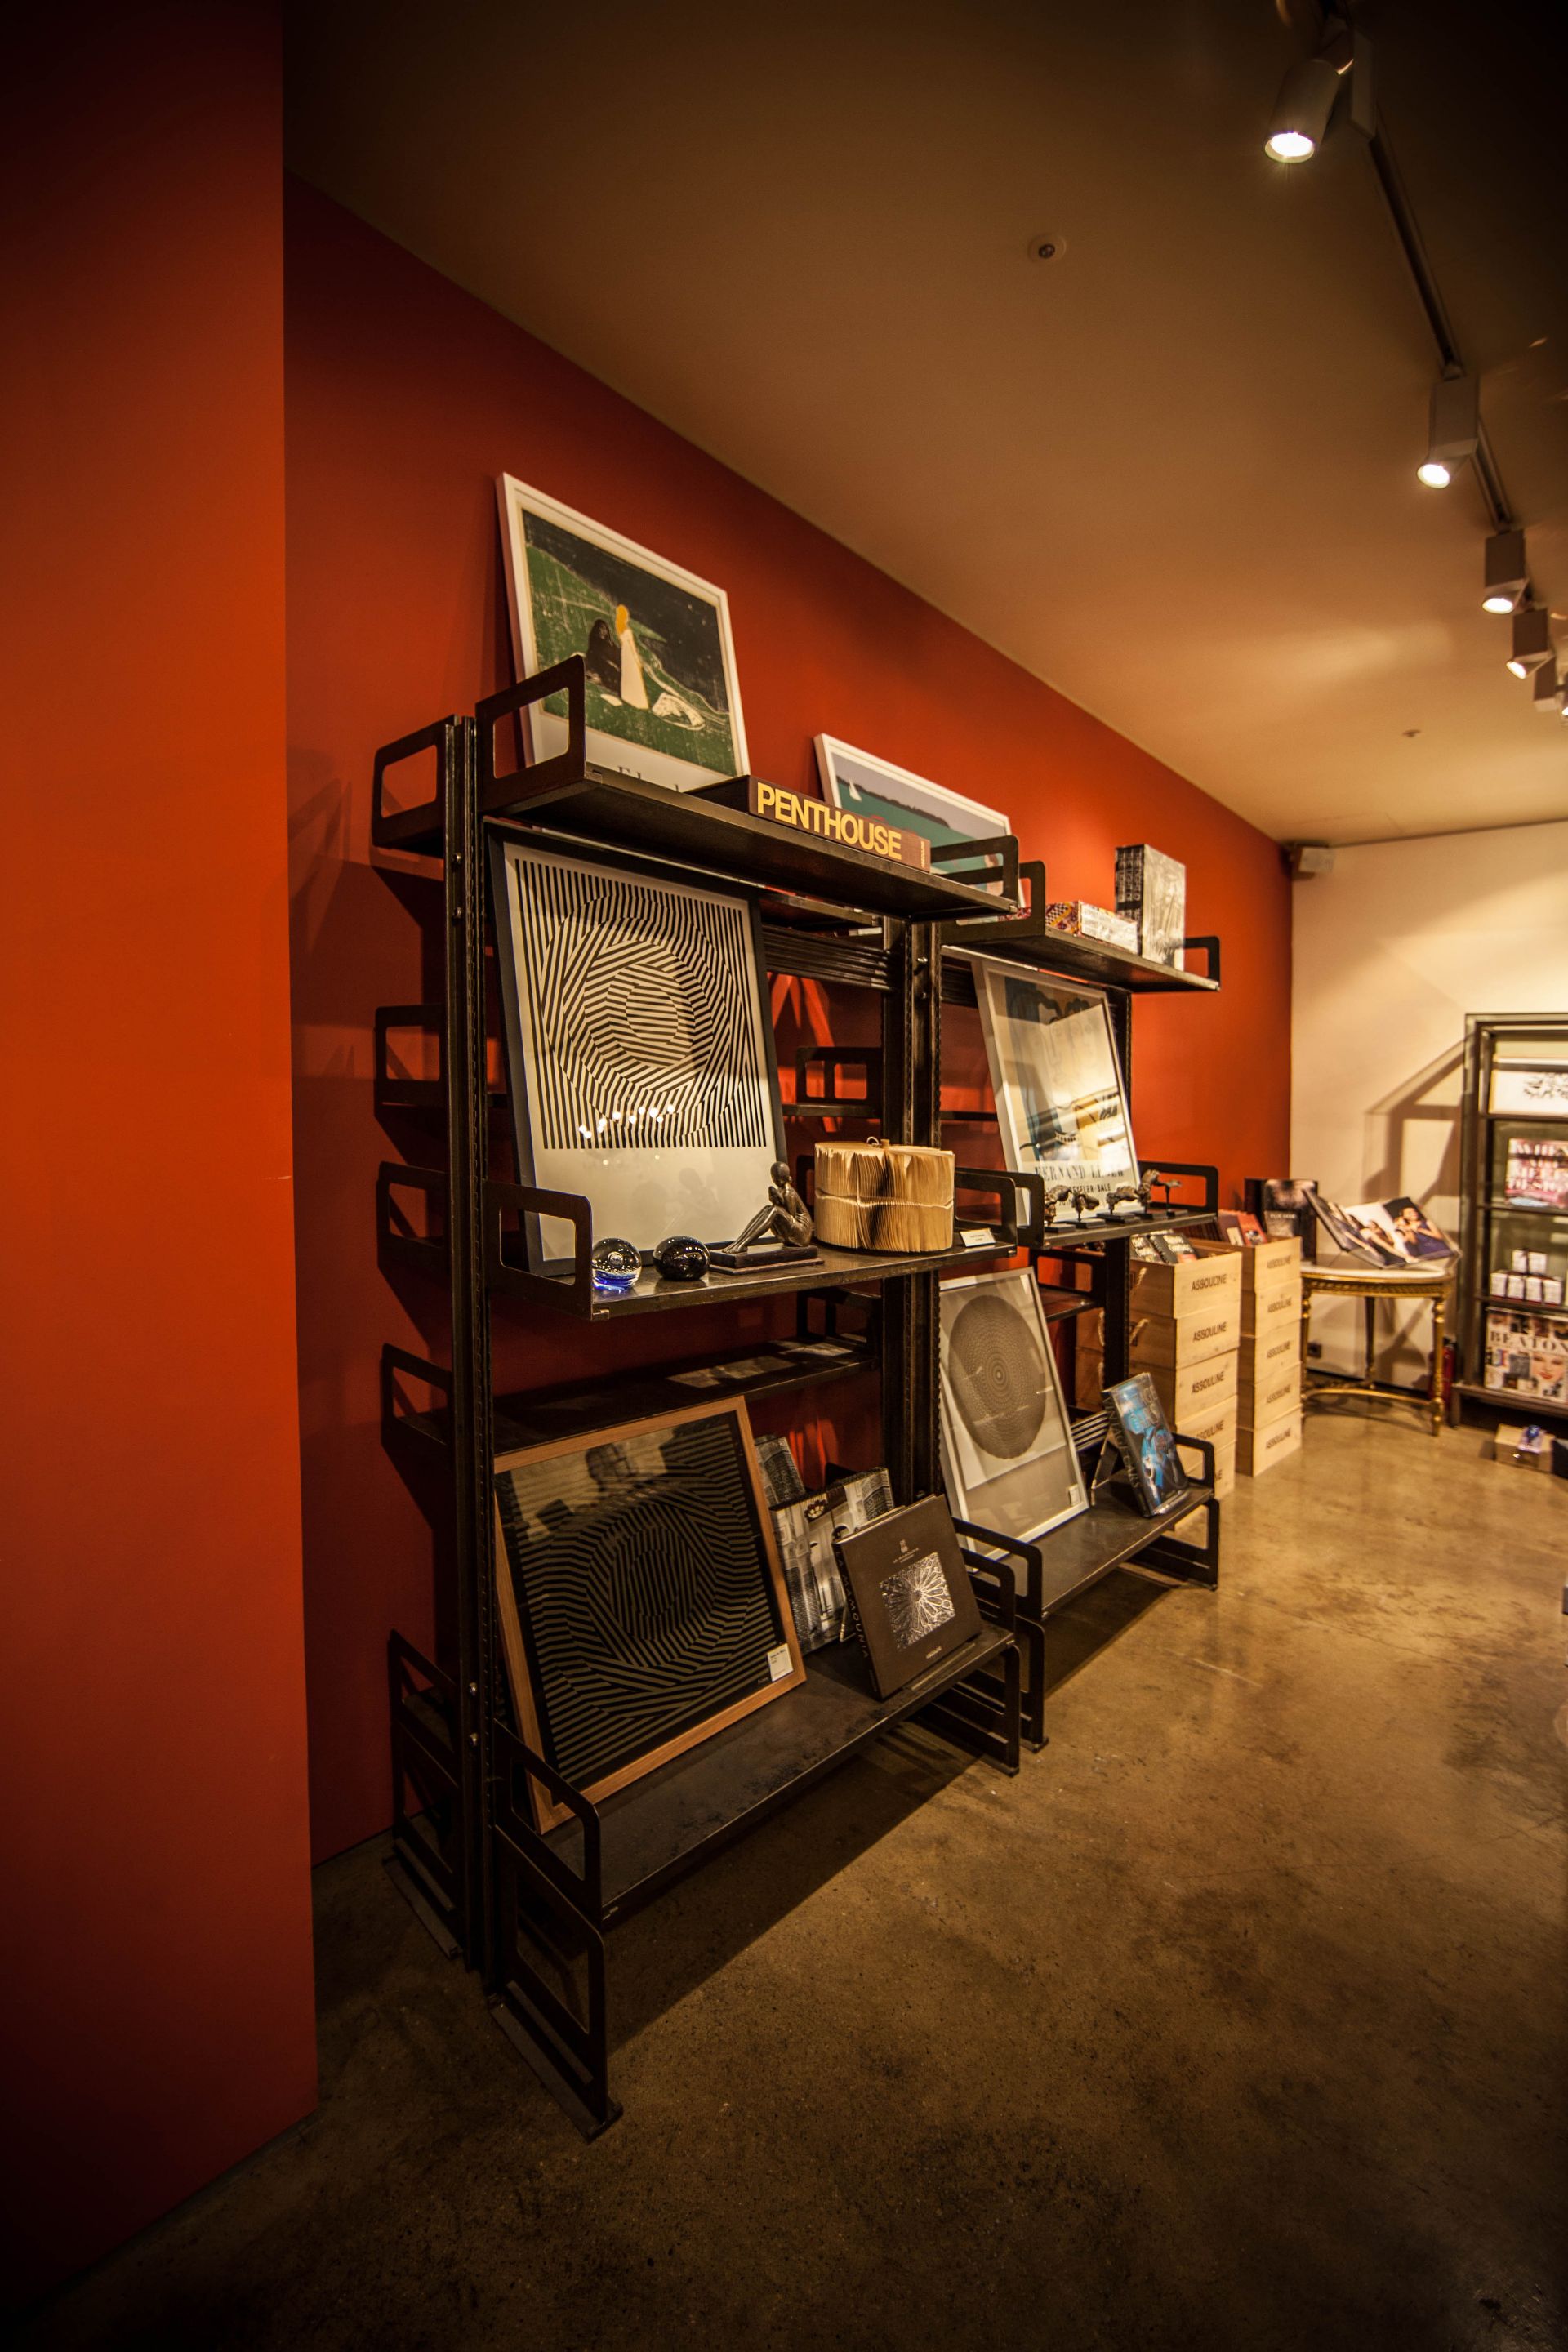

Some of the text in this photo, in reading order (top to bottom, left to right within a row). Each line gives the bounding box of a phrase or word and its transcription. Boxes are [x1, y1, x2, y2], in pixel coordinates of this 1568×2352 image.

[757, 782, 902, 860] PENTHOUSE
[1191, 1273, 1227, 1293] ASSOULINE
[1192, 1321, 1227, 1343] ASSOULINE
[1191, 1370, 1225, 1396] ASSOULINE
[842, 1574, 869, 1659] MAMOUNIA
